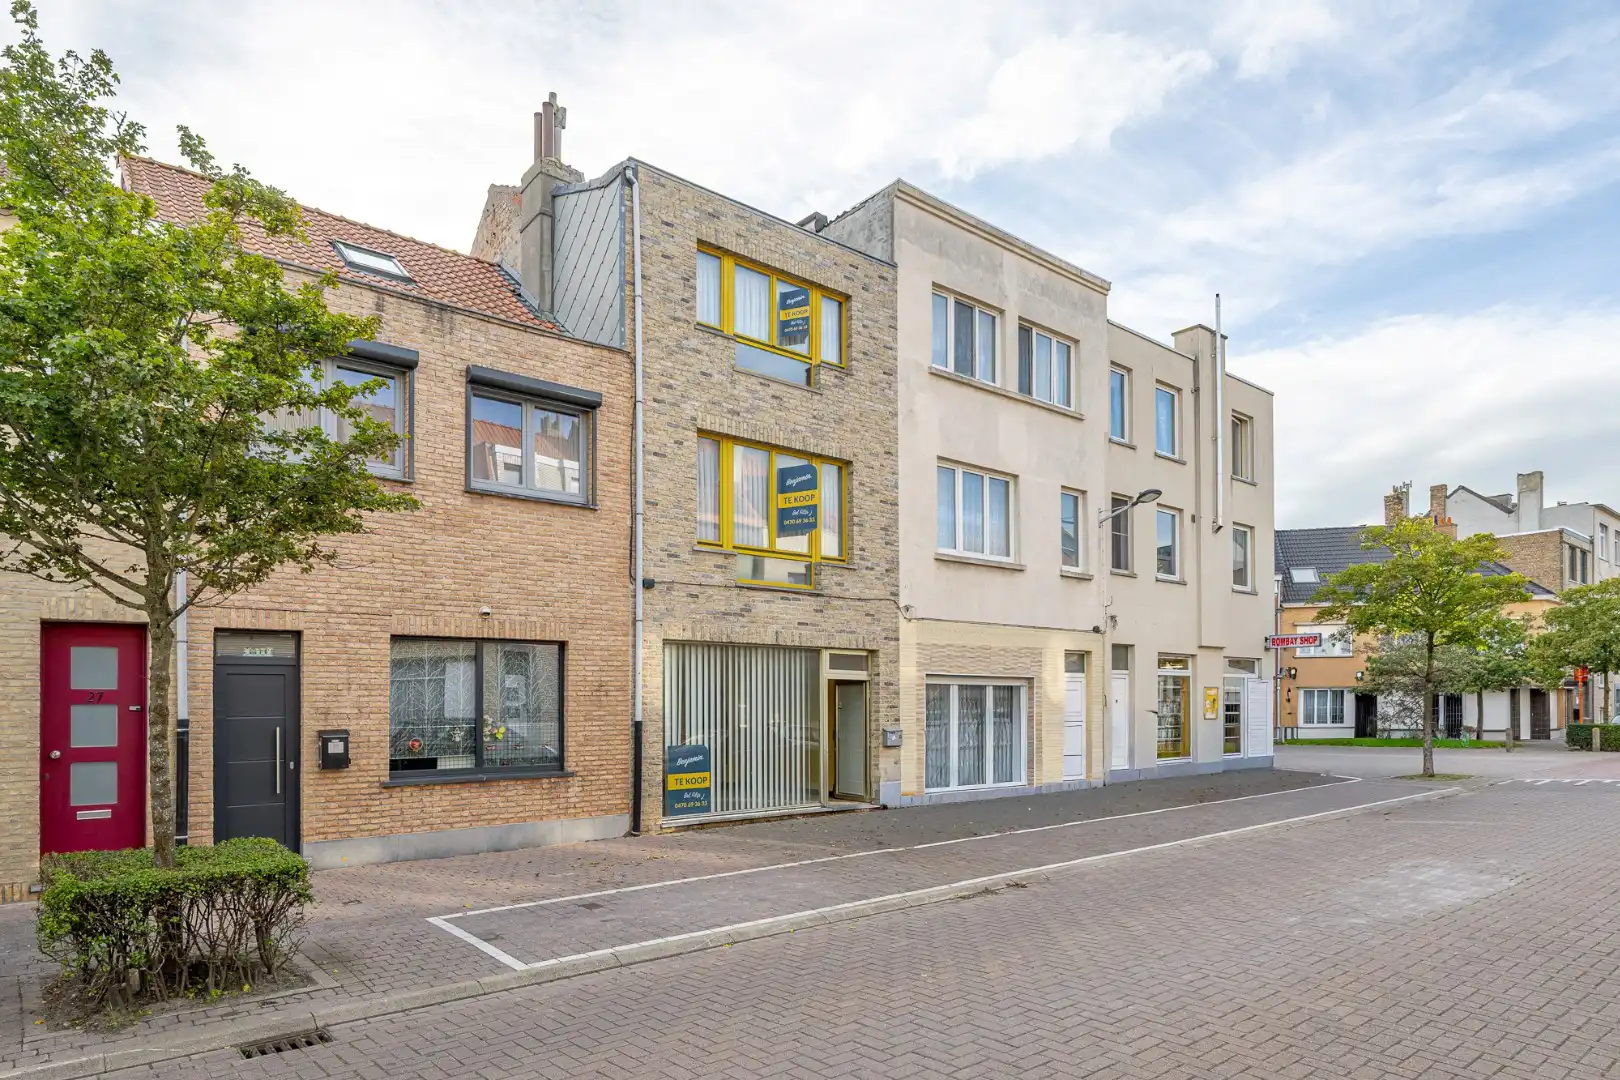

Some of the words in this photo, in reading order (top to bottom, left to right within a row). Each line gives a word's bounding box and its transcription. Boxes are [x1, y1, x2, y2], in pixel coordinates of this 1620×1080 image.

[794, 494, 815, 503] KOOP
[1300, 636, 1318, 644] SHOP
[86, 692, 104, 704] 27
